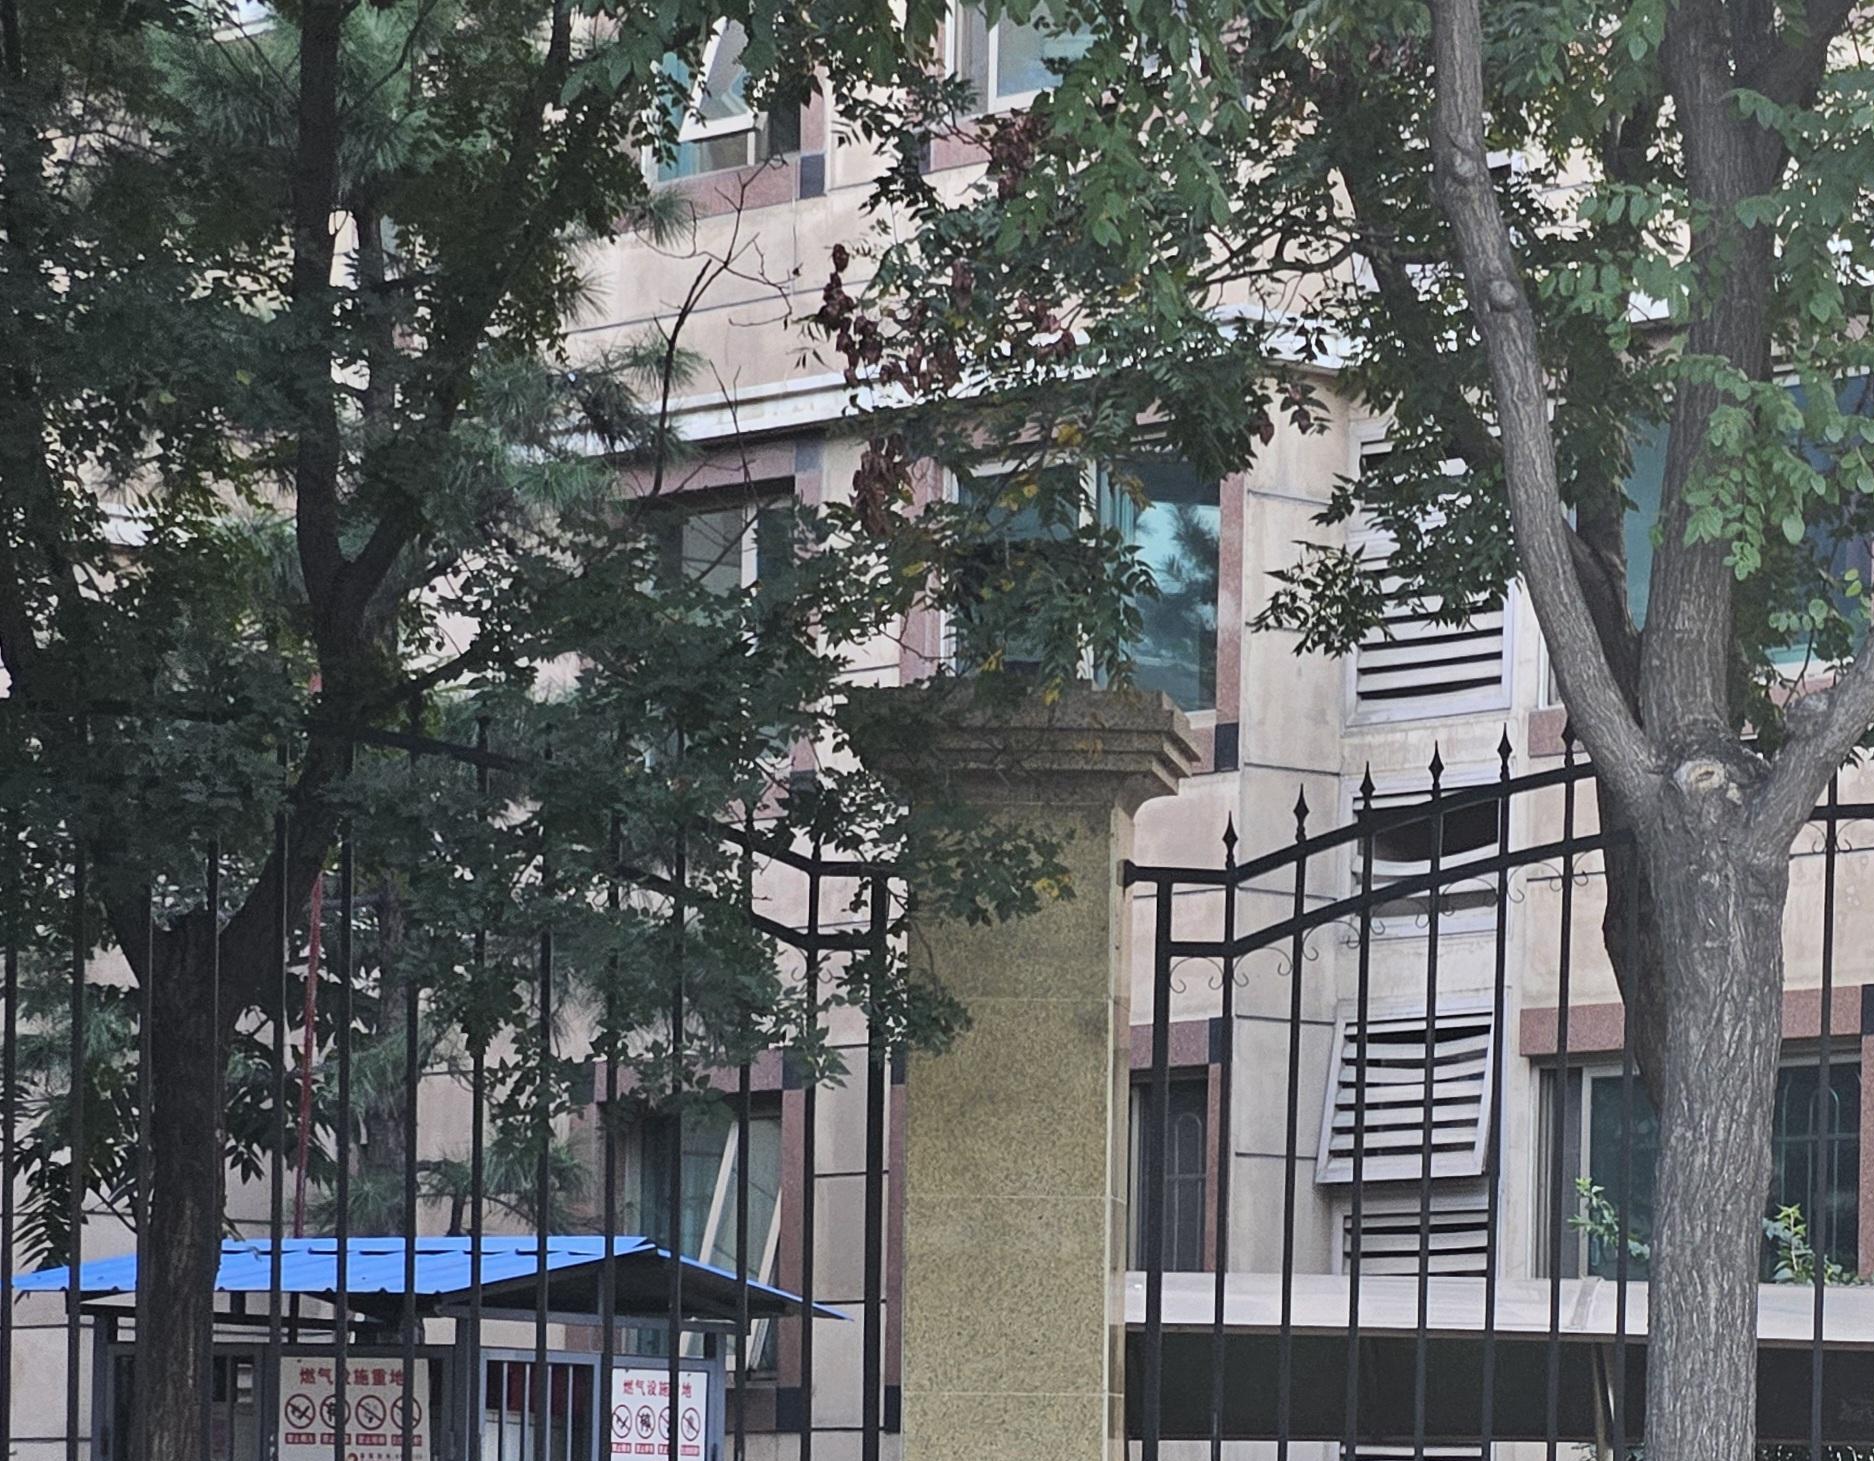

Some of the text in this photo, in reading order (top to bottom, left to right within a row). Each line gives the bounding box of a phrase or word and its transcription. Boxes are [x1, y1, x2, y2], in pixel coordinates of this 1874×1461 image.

[623, 1380, 692, 1399] 燃气设施地
